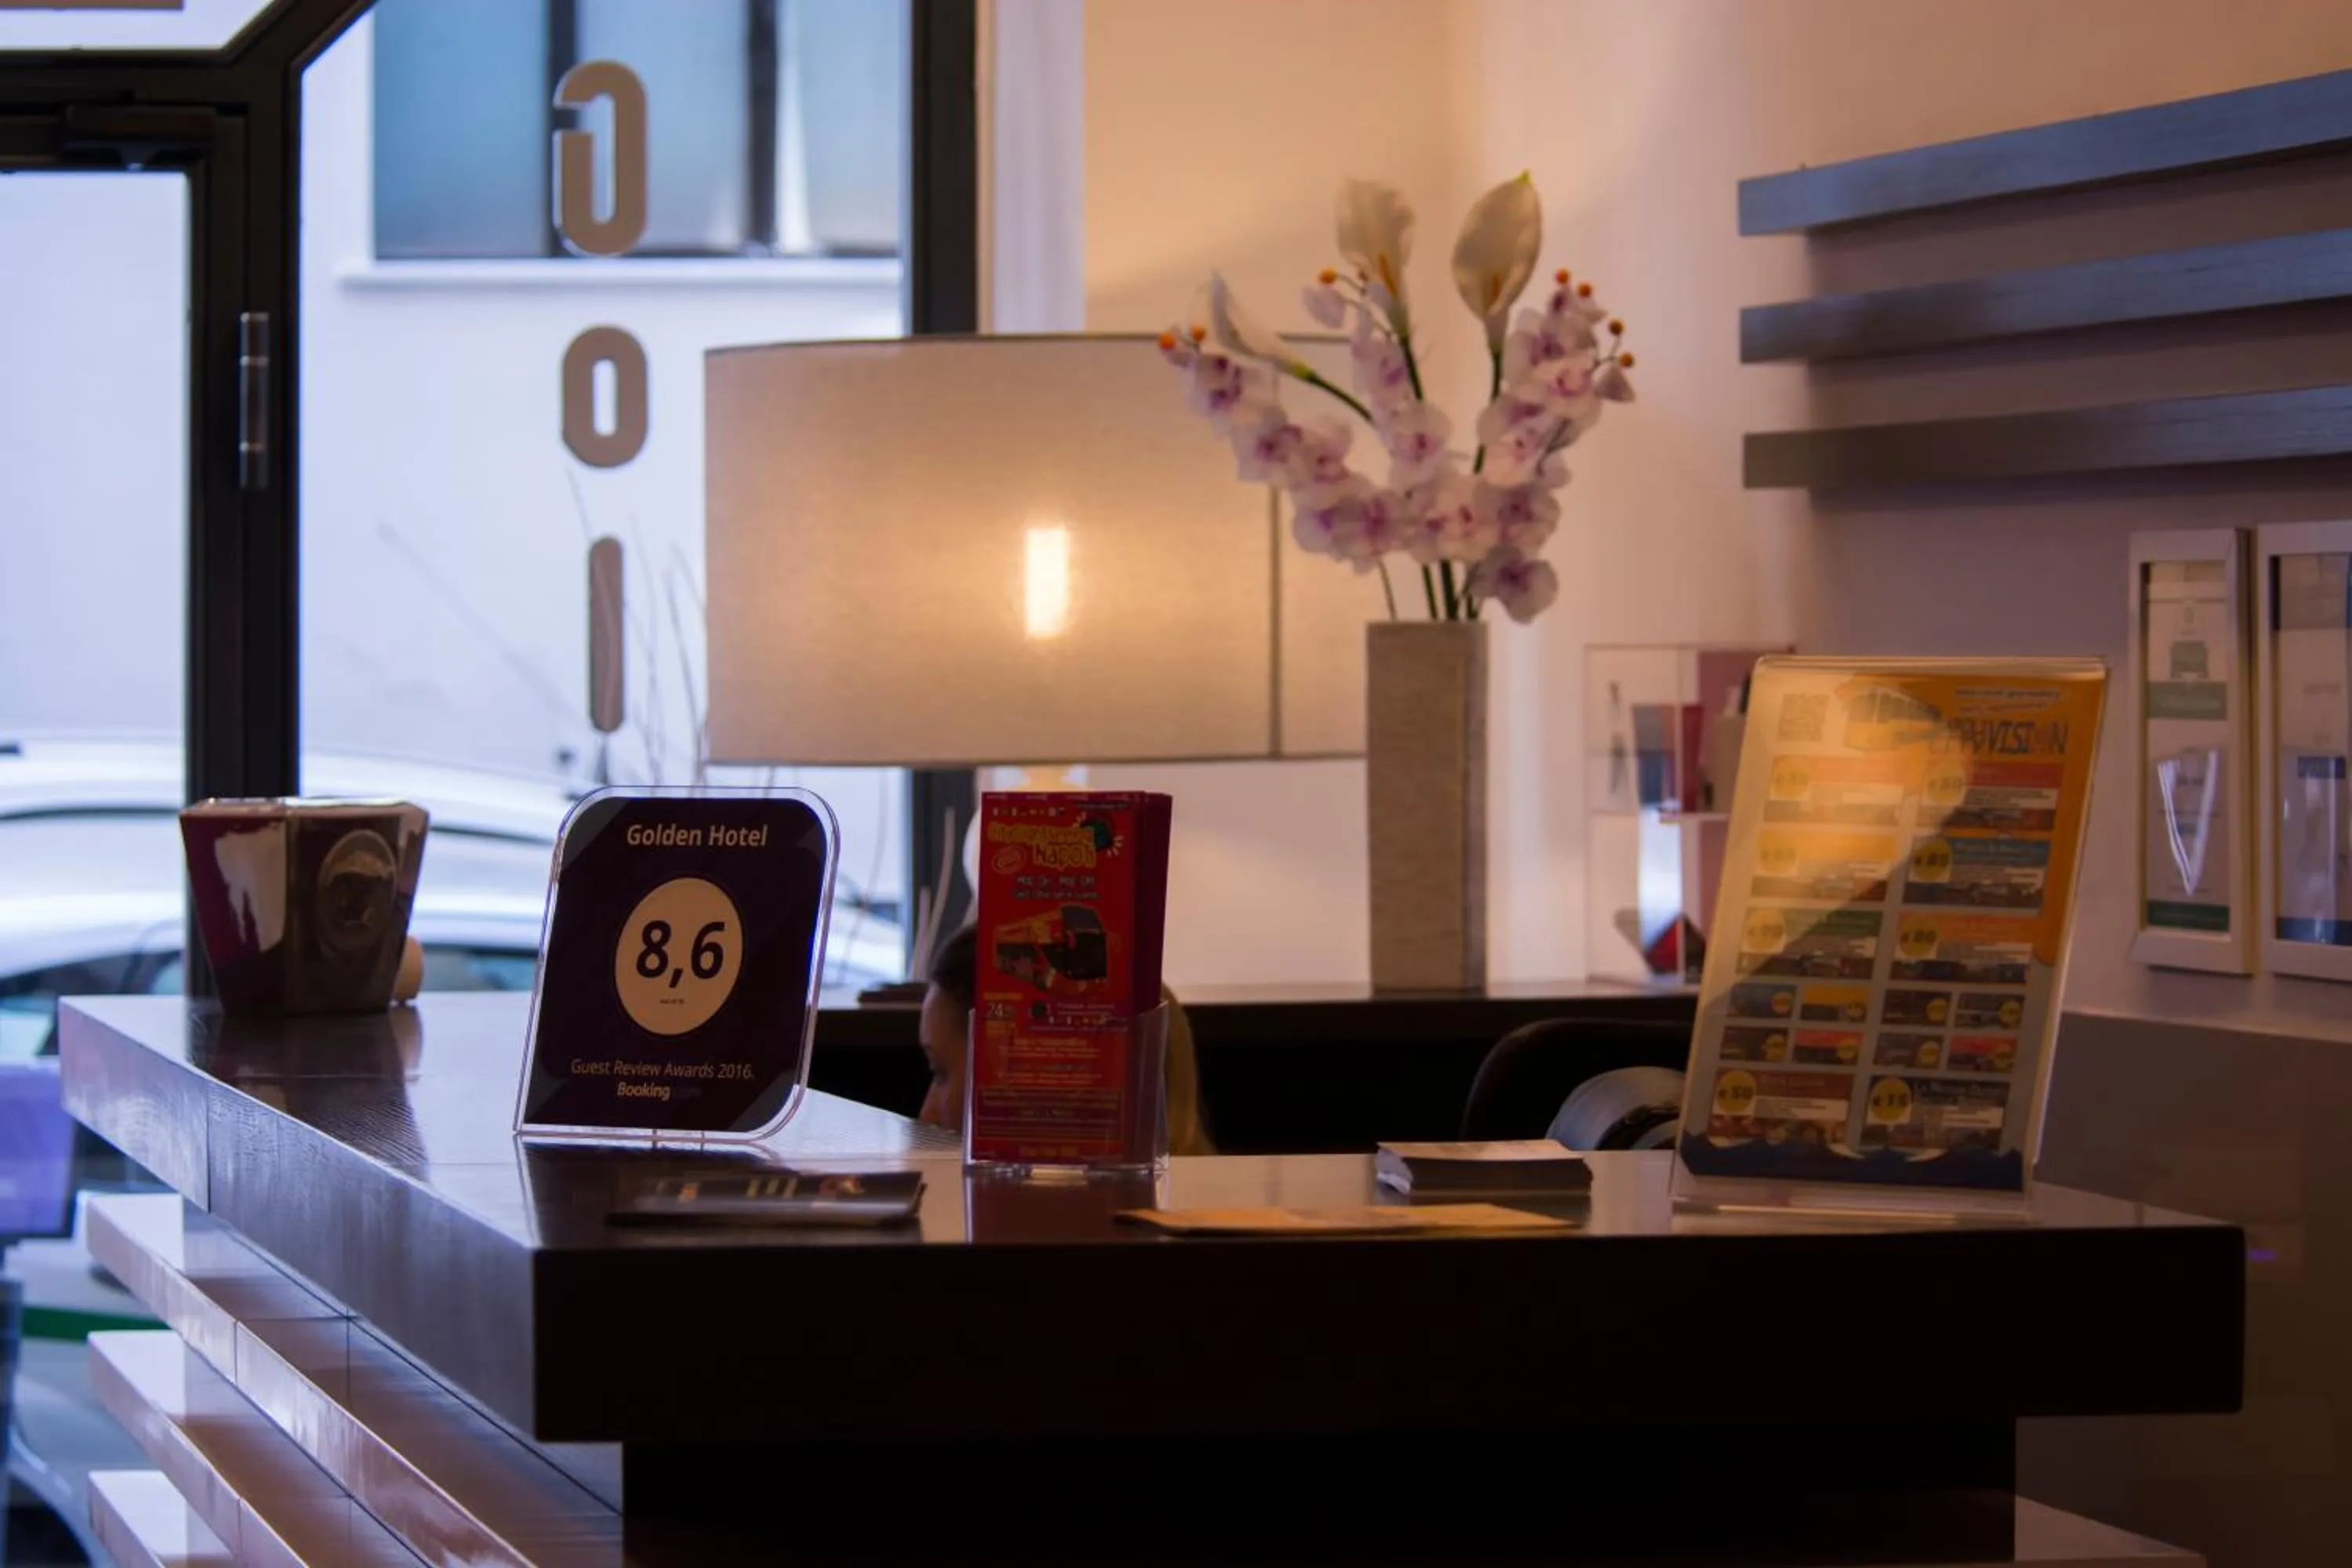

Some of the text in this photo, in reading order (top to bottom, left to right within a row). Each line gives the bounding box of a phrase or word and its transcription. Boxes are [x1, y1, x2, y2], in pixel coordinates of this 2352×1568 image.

[626, 823, 768, 848] Golden Hotel
[636, 920, 726, 989] 8,6
[570, 1058, 610, 1076] Guest
[613, 1059, 661, 1077] Review
[664, 1062, 714, 1079] Awards
